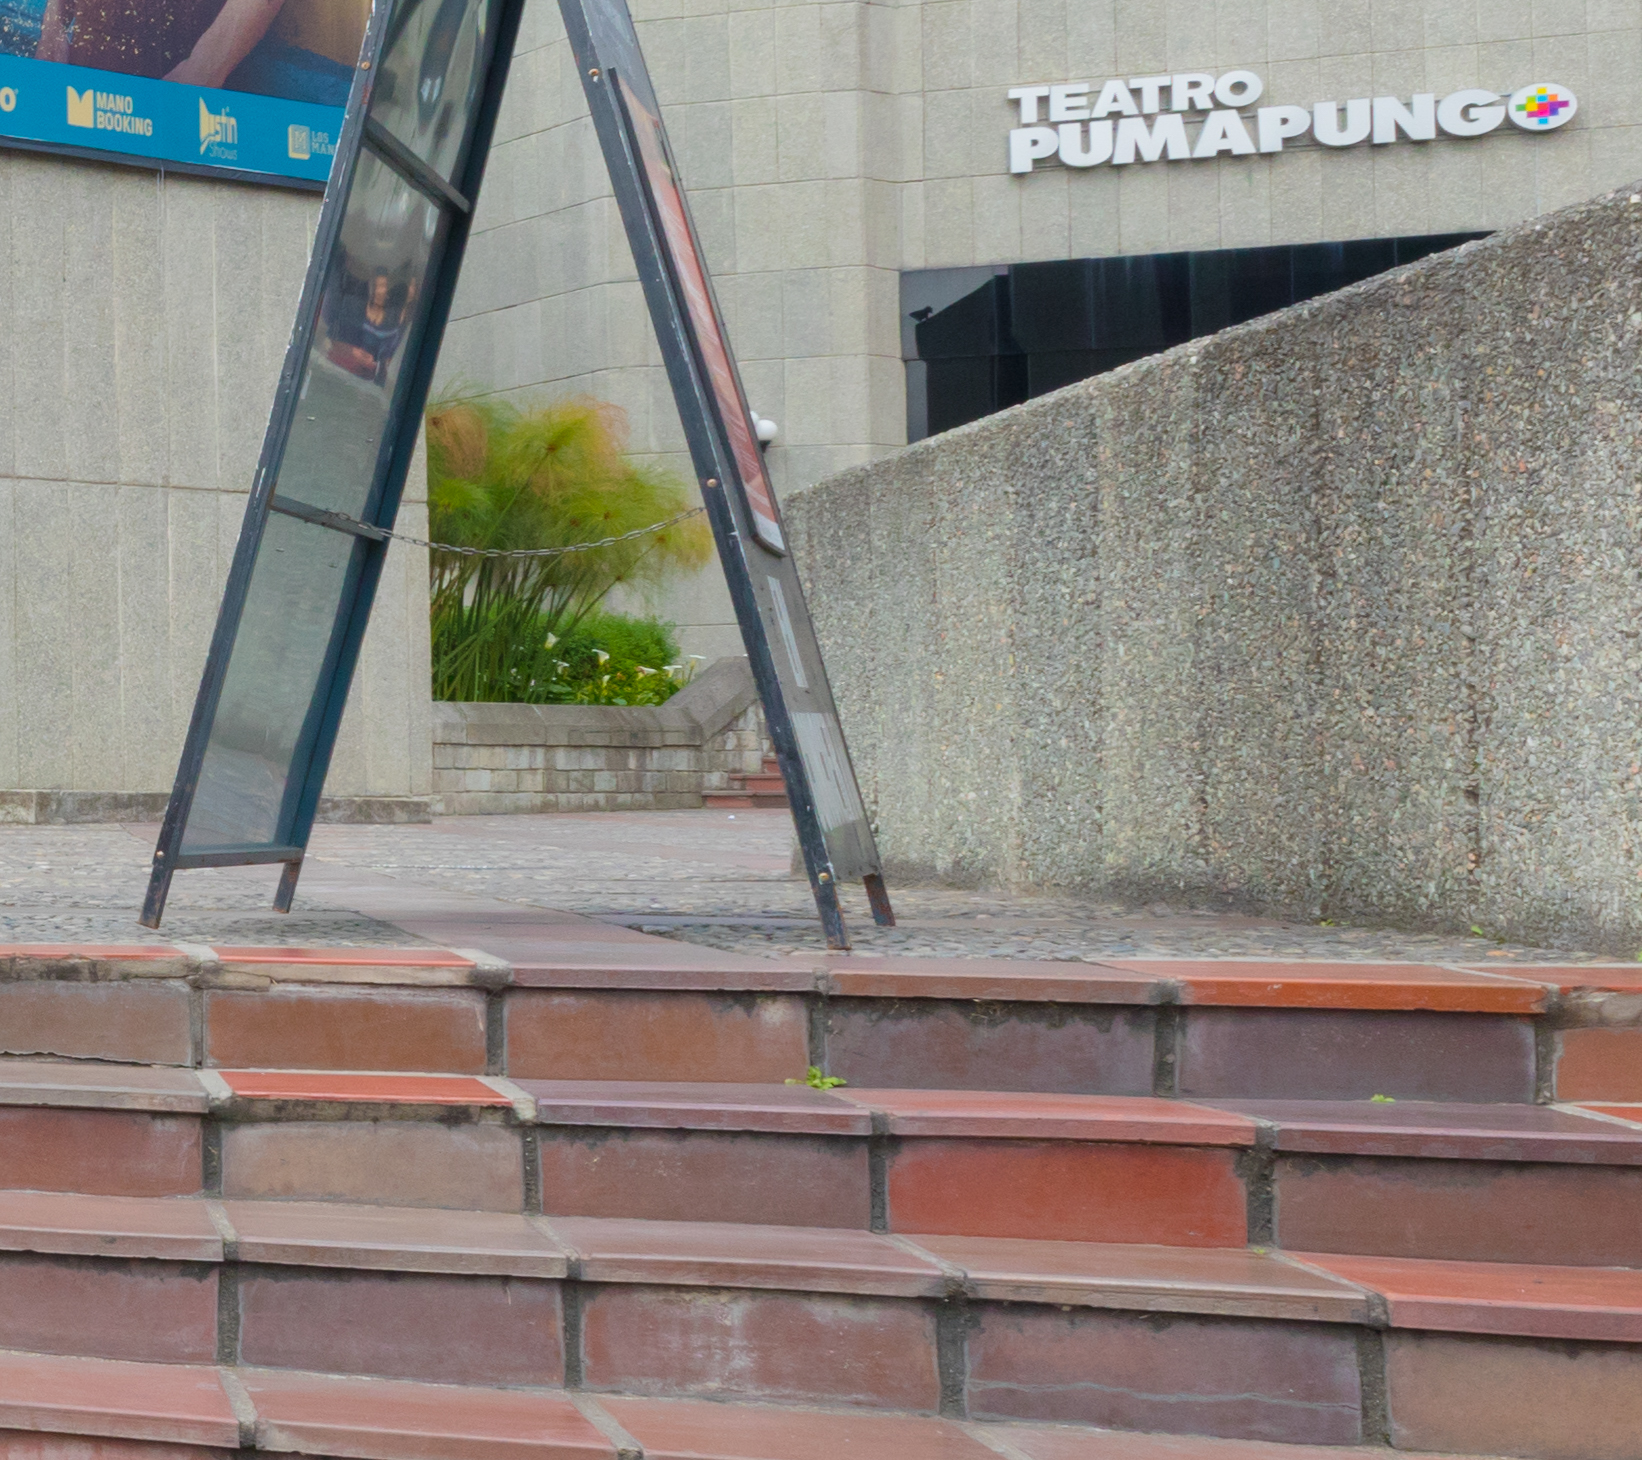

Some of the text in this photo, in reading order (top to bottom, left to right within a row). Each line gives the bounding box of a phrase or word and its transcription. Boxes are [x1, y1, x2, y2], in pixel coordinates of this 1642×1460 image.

[96, 91, 134, 114] MANO
[1008, 70, 1263, 125] TEATRO
[96, 111, 153, 137] BOOKING
[1009, 82, 1578, 174] PUMAPUNGO
